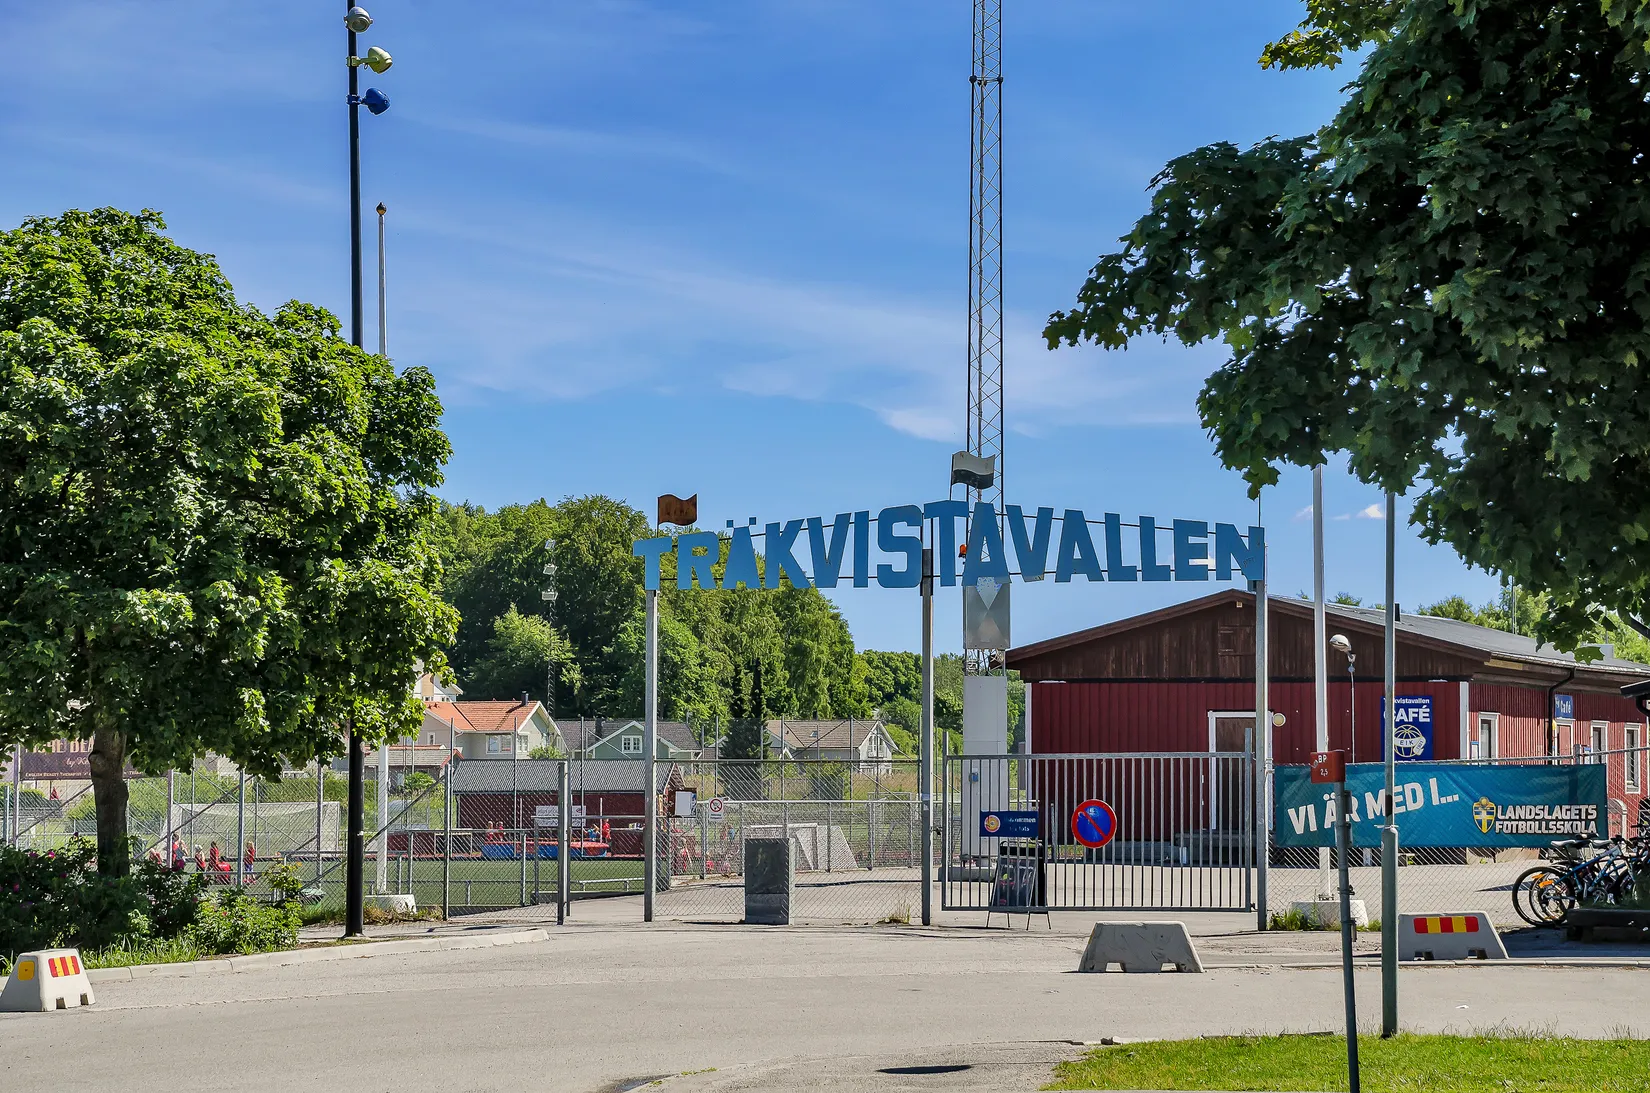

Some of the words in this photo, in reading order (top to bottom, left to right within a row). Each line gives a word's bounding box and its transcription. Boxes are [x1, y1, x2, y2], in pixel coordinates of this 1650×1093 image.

[633, 500, 1265, 590] TRÄKVISTAVALLEN
[1318, 754, 1328, 763] BP
[1287, 803, 1318, 835] VI
[1364, 782, 1424, 820] MED
[1496, 804, 1598, 820] LANDSLAGETS
[1495, 820, 1598, 834] FOTBOLLSSKOLA
